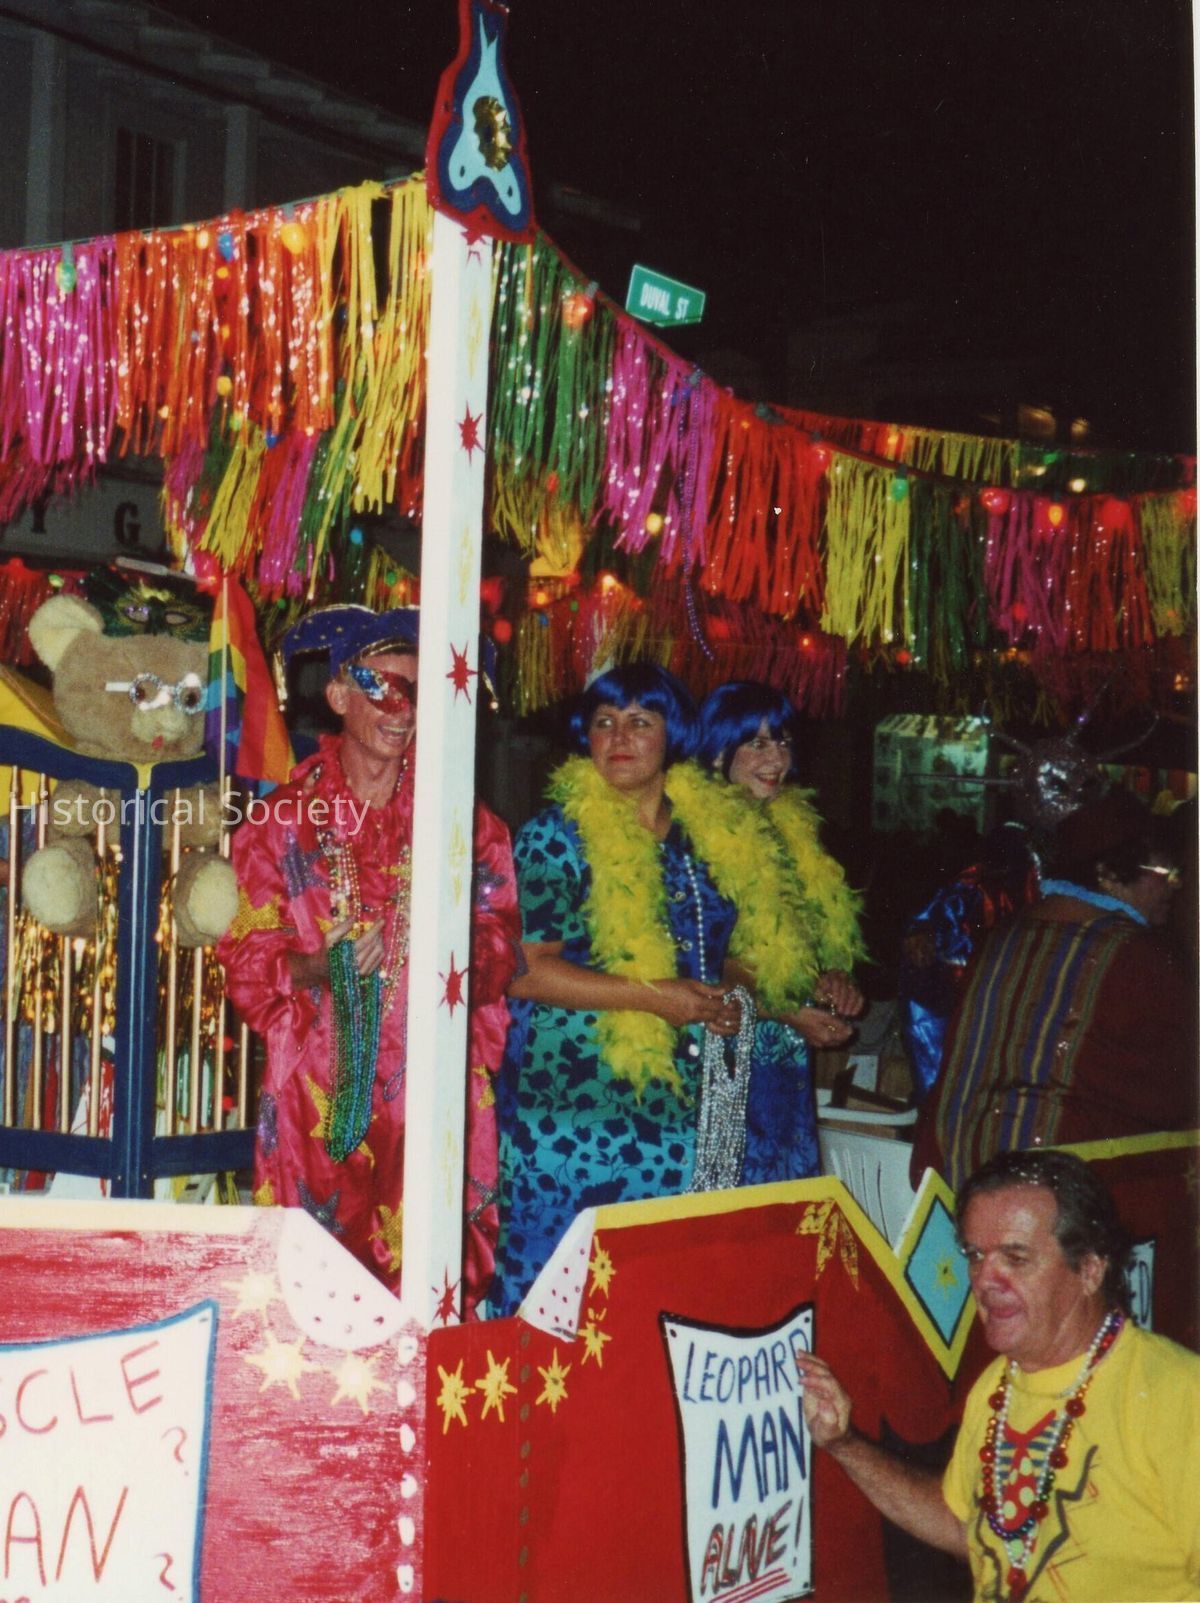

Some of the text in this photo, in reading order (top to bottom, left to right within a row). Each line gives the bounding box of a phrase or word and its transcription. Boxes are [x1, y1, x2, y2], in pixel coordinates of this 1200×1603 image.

[640, 282, 689, 321] DUVAL ST
[682, 1327, 810, 1404] LEOPARD
[711, 1395, 806, 1510] MAN
